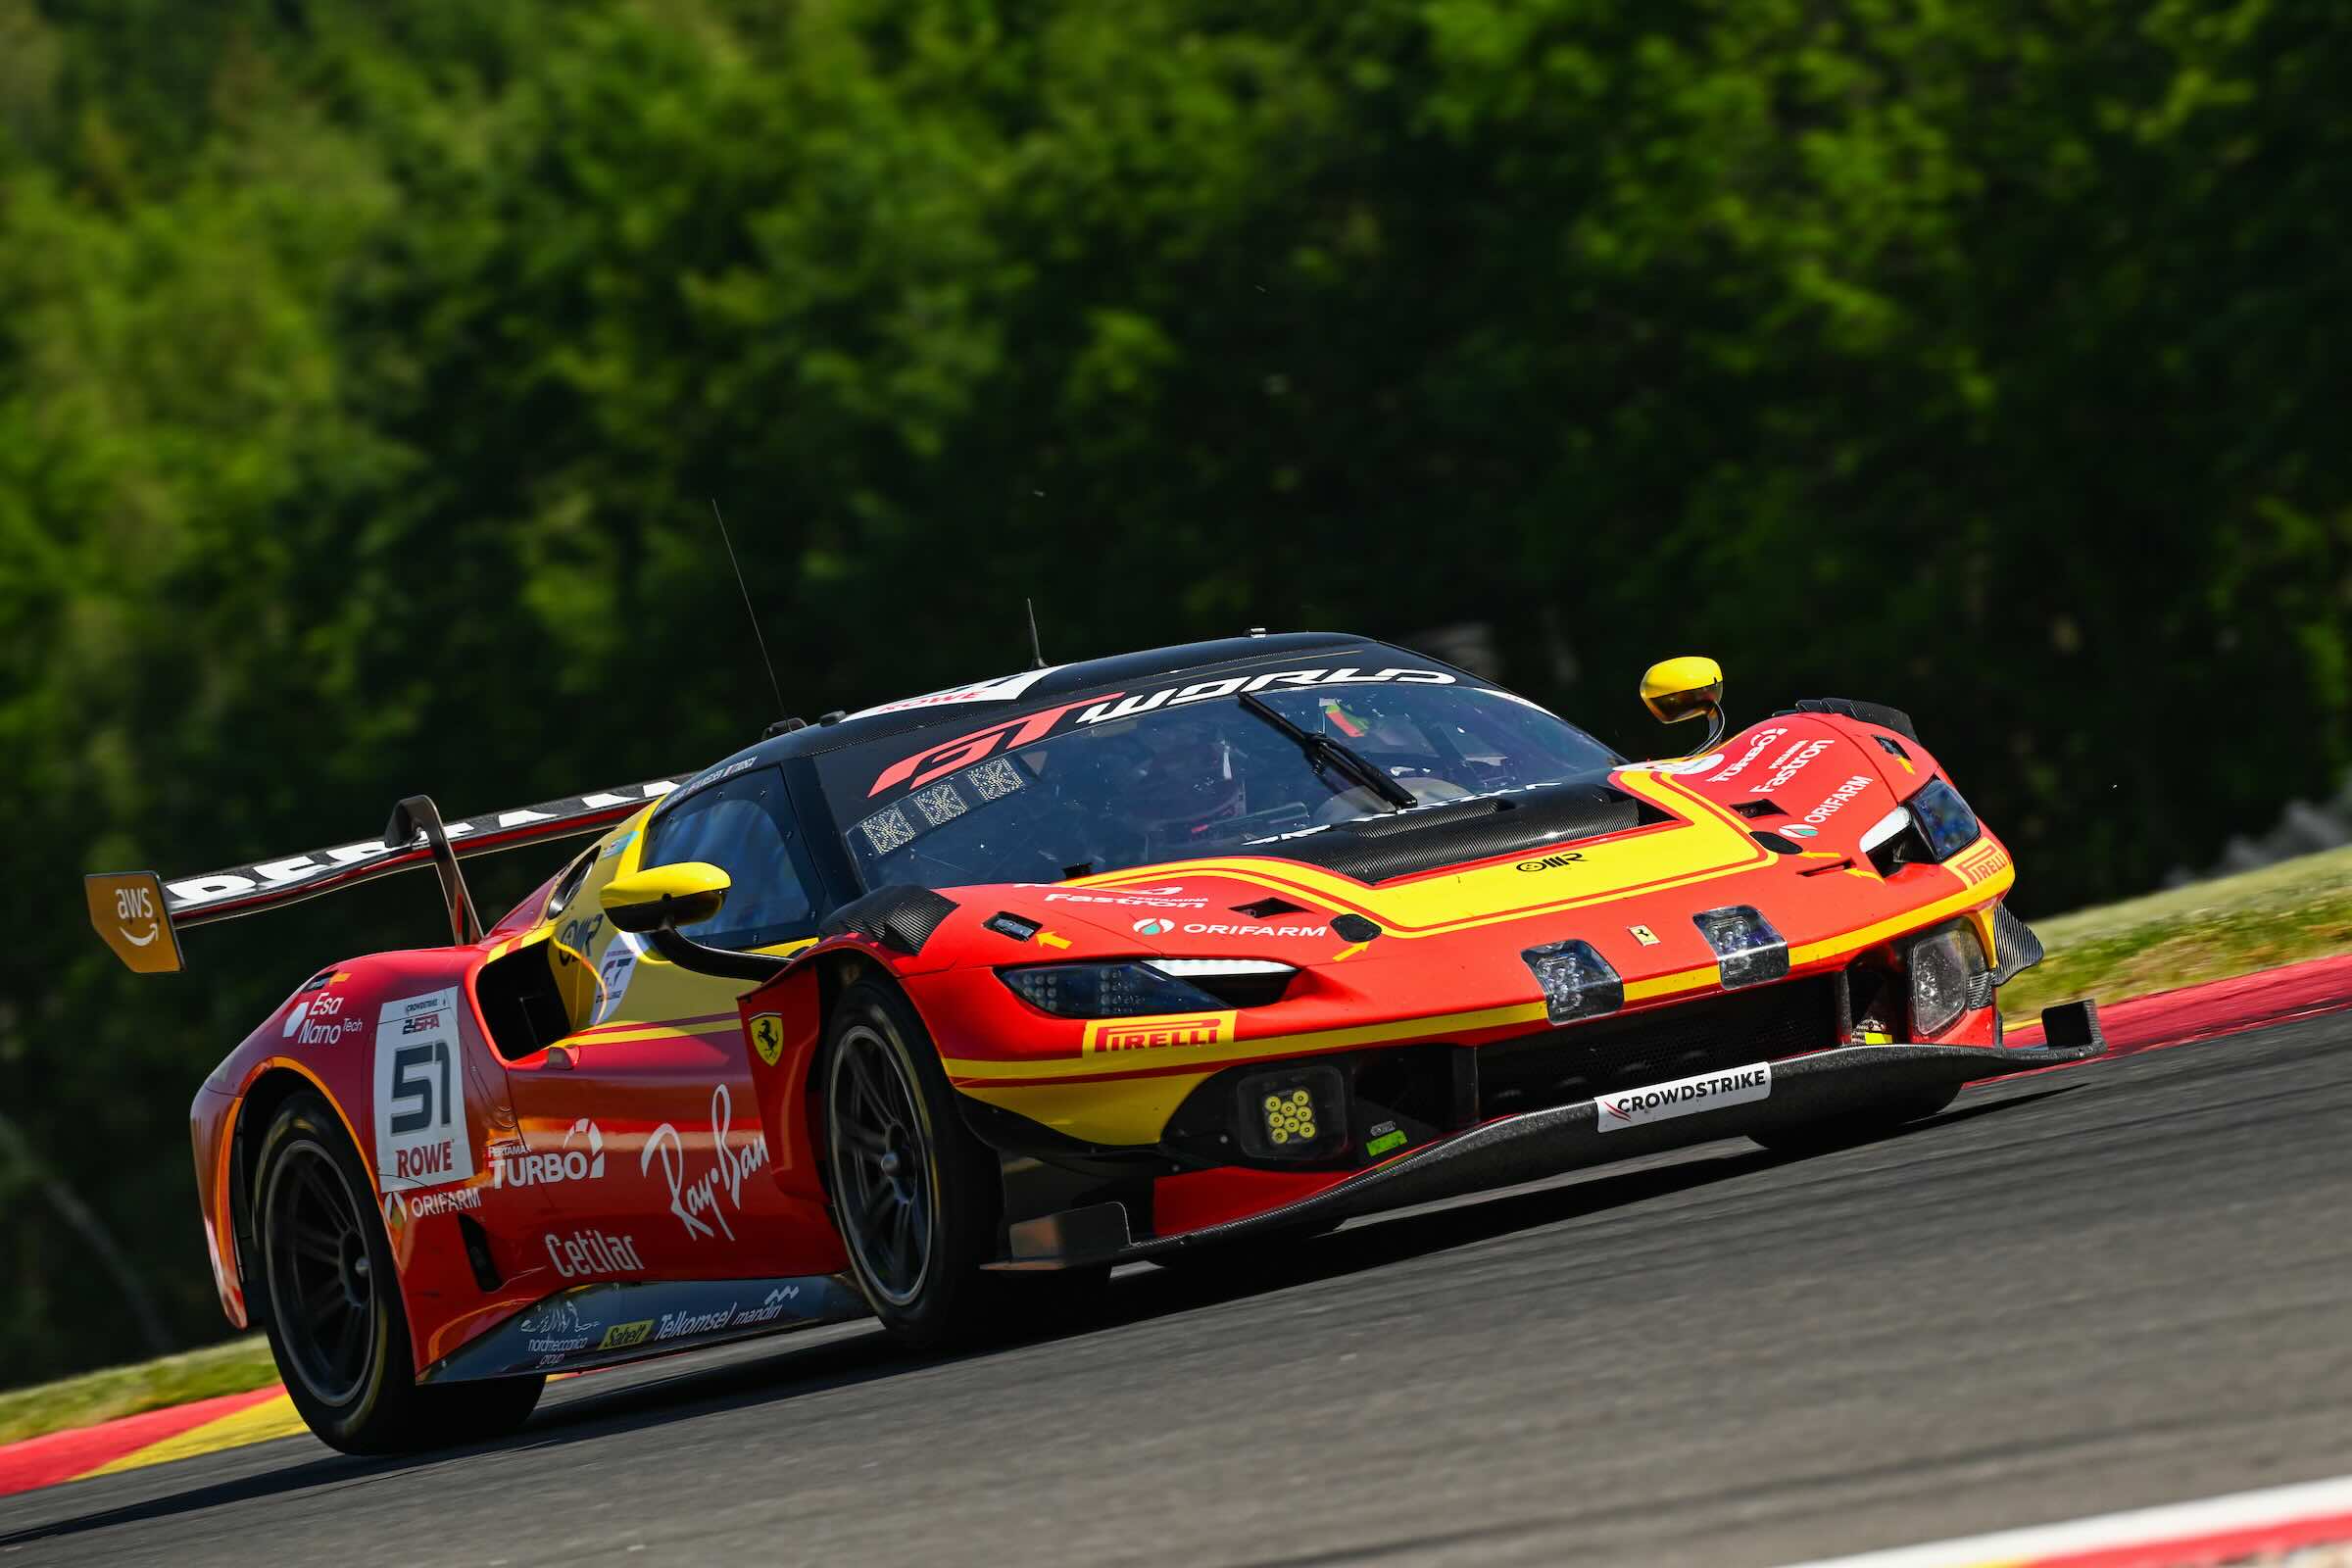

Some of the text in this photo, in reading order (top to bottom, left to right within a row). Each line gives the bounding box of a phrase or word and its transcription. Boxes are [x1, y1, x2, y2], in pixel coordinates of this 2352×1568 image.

[867, 668, 1457, 799] GT WORLD
[1706, 734, 1777, 782] TURBO
[1749, 739, 1836, 793] Fastron
[1803, 775, 1875, 823] ORIFARM
[1955, 845, 2010, 886] PIRELLI
[115, 887, 154, 919] aws
[1043, 893, 1205, 908] Fastron
[1183, 922, 1328, 938] ORIFARM
[309, 992, 345, 1015] Esa
[297, 1017, 364, 1045] Nano Tech
[1095, 1018, 1221, 1053] PIRELLI
[390, 1038, 451, 1138] 51
[1617, 1069, 1766, 1113] CROWDSTRIKE
[395, 1141, 454, 1178] ROWE
[488, 1151, 588, 1190] TURBO
[411, 1188, 482, 1218] ORIFARM
[545, 1230, 645, 1278] Cetilar
[654, 1301, 738, 1342] Telkomsel
